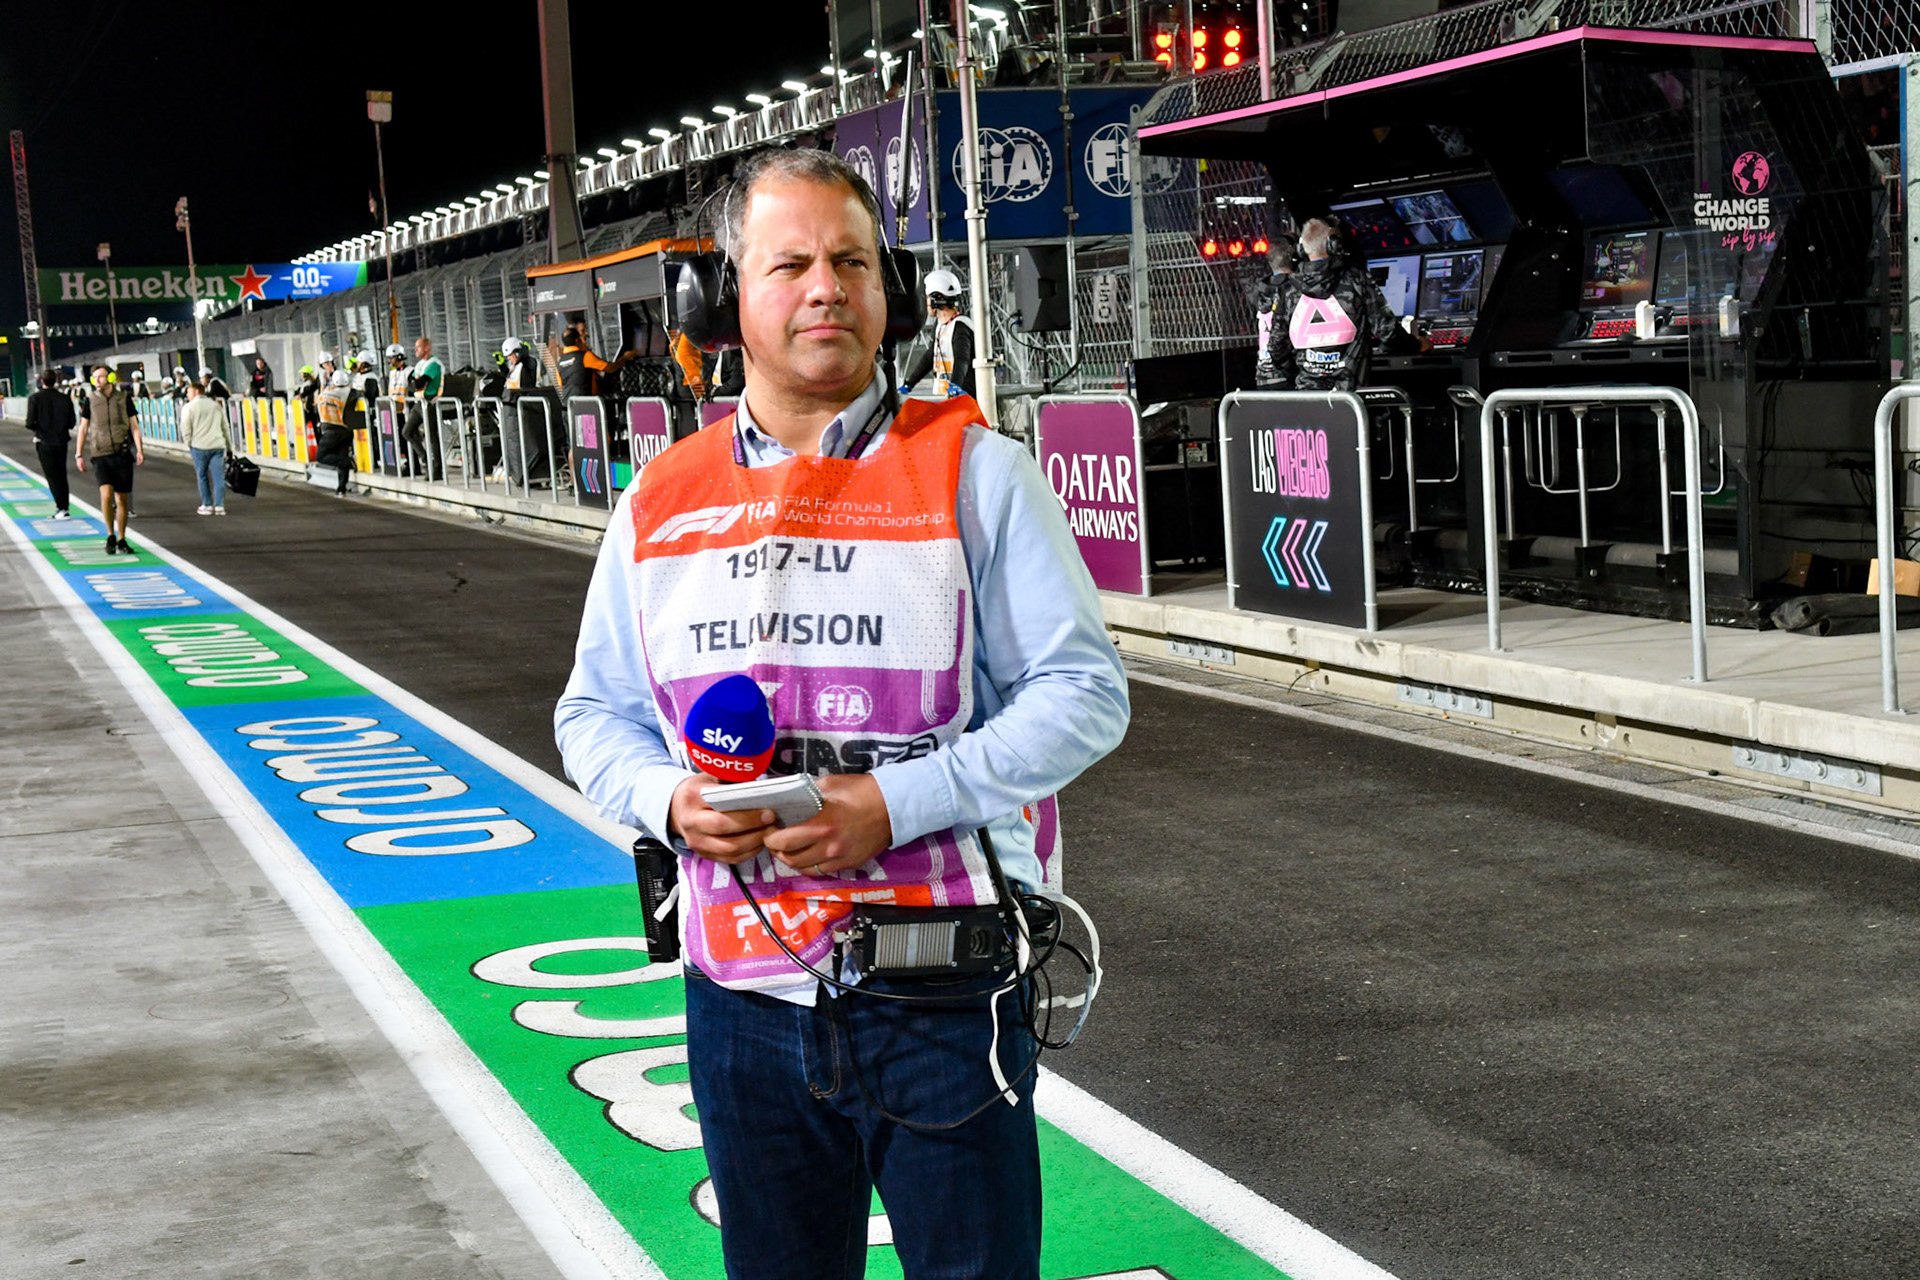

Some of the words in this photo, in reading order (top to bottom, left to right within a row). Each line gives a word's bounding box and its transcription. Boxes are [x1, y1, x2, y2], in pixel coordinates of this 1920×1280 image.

[1694, 198, 1769, 217] CHANGE
[1710, 215, 1770, 231] WORLD
[1722, 233, 1739, 251] sip
[1743, 225, 1756, 251] by
[1759, 230, 1775, 247] sip
[59, 270, 227, 300] Heineken
[1317, 353, 1340, 361] BWT
[1250, 429, 1277, 494] LAS
[1274, 428, 1330, 500] VEGAS
[1047, 452, 1136, 511] QATAR
[815, 498, 881, 513] Formula
[885, 501, 892, 513] 1
[784, 509, 831, 525] World
[835, 512, 945, 528] Championship
[1070, 507, 1138, 542] AIRWAYS
[727, 543, 857, 579] 1917-LV
[702, 728, 743, 753] sky
[691, 748, 755, 772] sports
[235, 716, 537, 856] aramco
